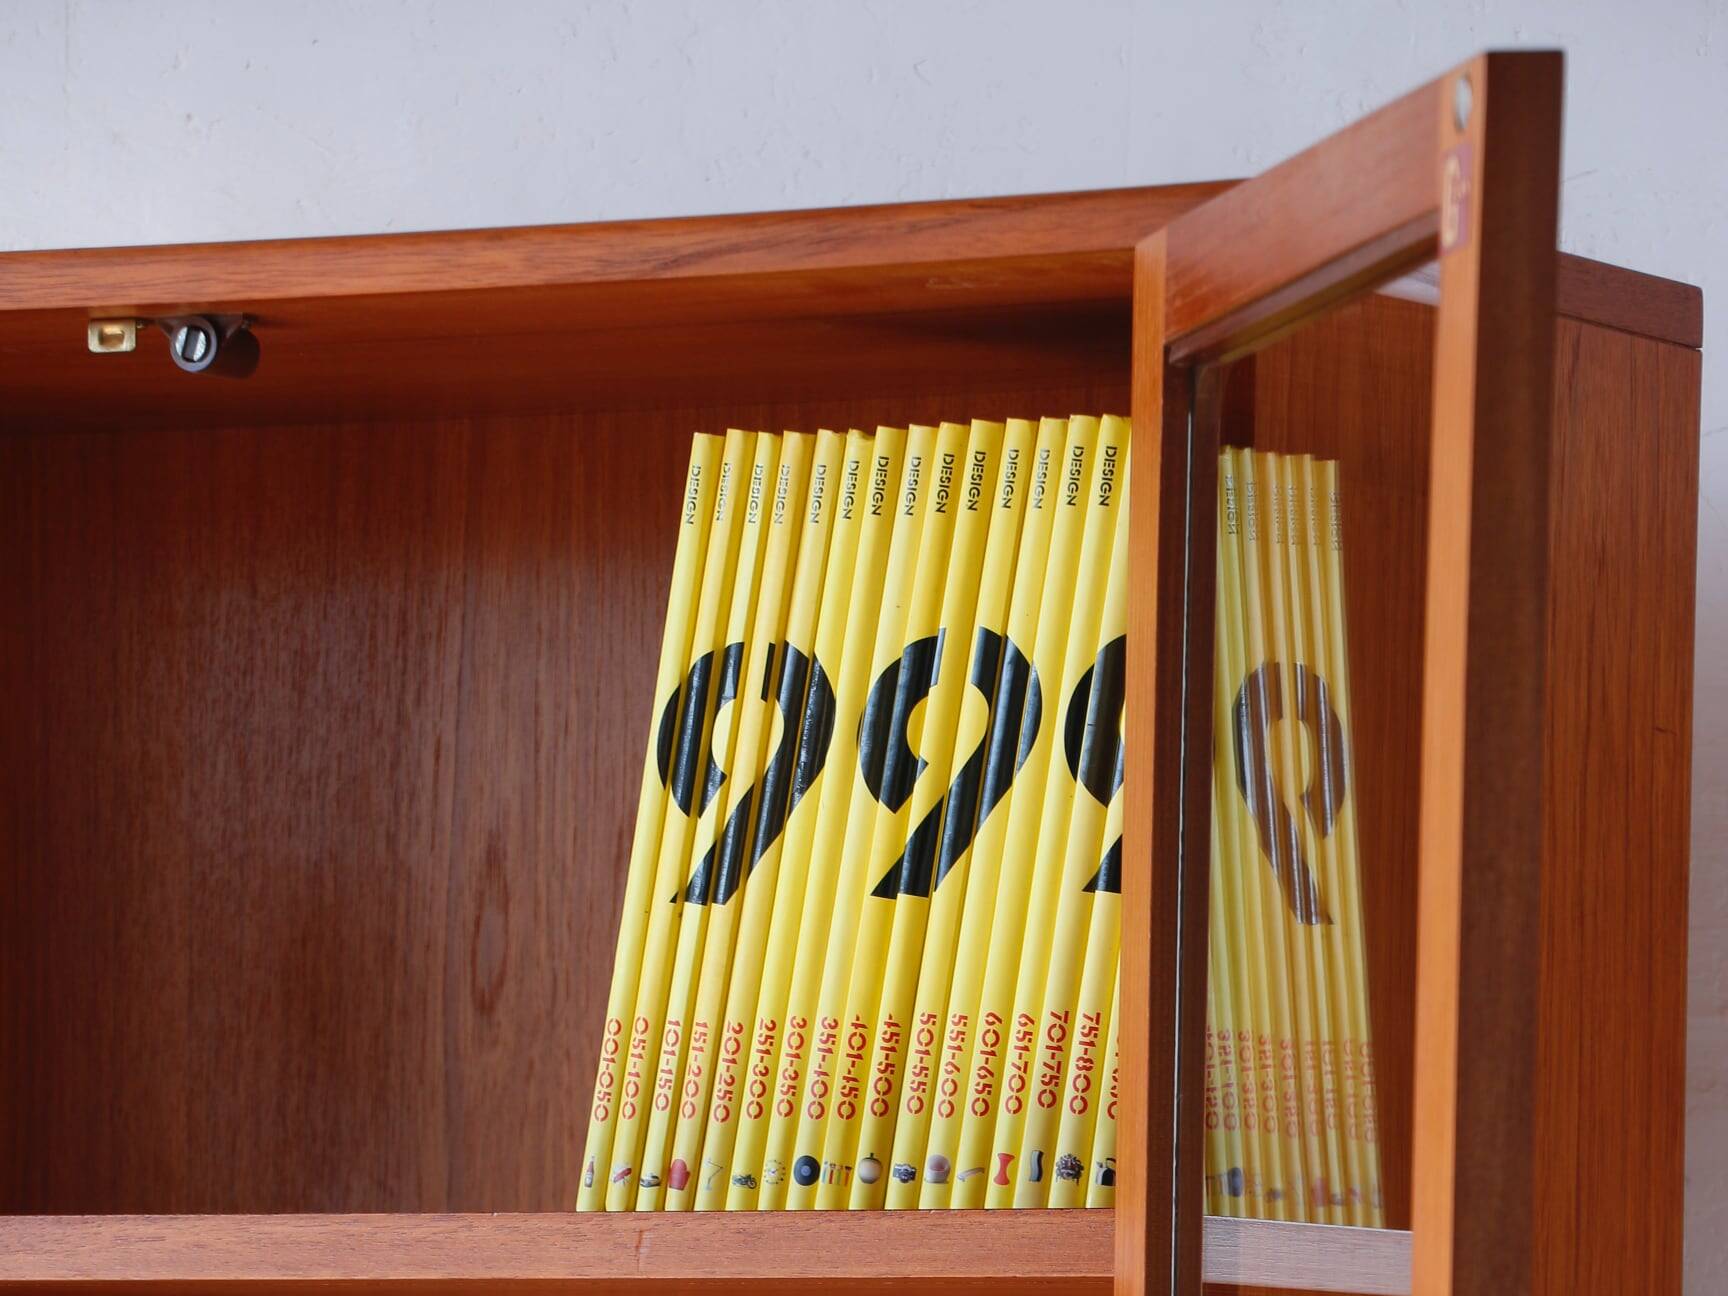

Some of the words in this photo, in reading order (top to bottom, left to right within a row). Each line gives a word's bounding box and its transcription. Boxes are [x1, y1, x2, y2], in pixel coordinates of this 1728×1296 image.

[686, 464, 701, 525] DESIGN
[748, 464, 763, 524] DESIGN
[774, 464, 790, 524] DESIGN
[810, 464, 827, 524] DESIGN
[842, 460, 860, 520] DESIGN
[871, 456, 890, 516] DESIGN
[904, 456, 921, 516] DESIGN
[935, 453, 955, 513] DESIGN
[967, 450, 986, 511] DESIGN
[1001, 449, 1020, 509] DESIGN
[1033, 448, 1051, 509] DESIGN
[1066, 446, 1084, 506] DESIGN
[1098, 446, 1118, 507] DESIGN
[594, 1018, 622, 1122] 001-050
[622, 1016, 649, 1120] 051-100
[655, 1020, 680, 1111] 101-150
[682, 1020, 708, 1120] 151-200
[714, 1020, 744, 1123] 201-250
[746, 1017, 777, 1120] 251-300
[777, 1015, 807, 1118] 301-350
[807, 1016, 839, 1120] 351-400
[837, 1014, 868, 1120] 401-450
[870, 1013, 901, 1118] 451-500
[906, 1012, 937, 1115] 501-550
[938, 1013, 968, 1119] 551-600
[971, 1012, 1003, 1117] 601-650
[1005, 1013, 1035, 1115] 651-700
[1037, 1010, 1069, 1109] 701-750
[1069, 1012, 1101, 1115] 751-800
